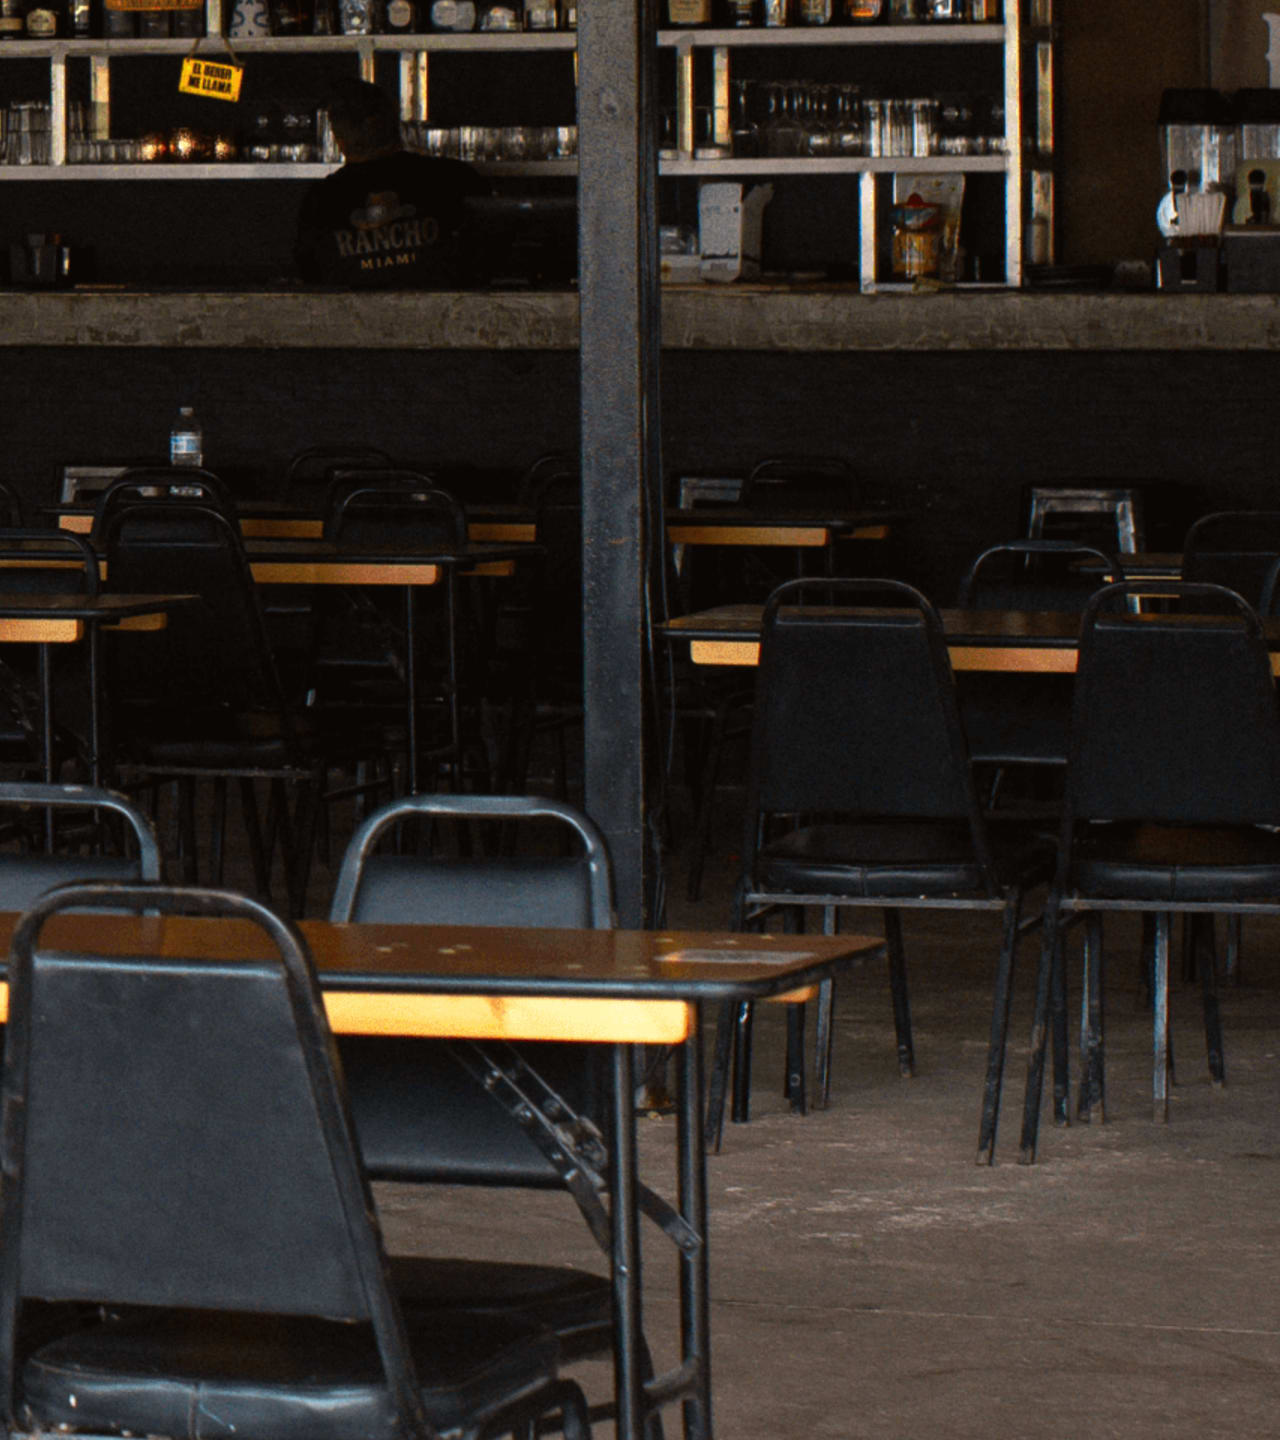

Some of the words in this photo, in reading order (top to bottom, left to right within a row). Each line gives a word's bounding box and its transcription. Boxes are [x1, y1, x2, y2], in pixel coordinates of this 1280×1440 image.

[202, 77, 231, 94] LLAMA
[335, 215, 440, 257] RANCHO
[360, 252, 416, 270] MIAMI
